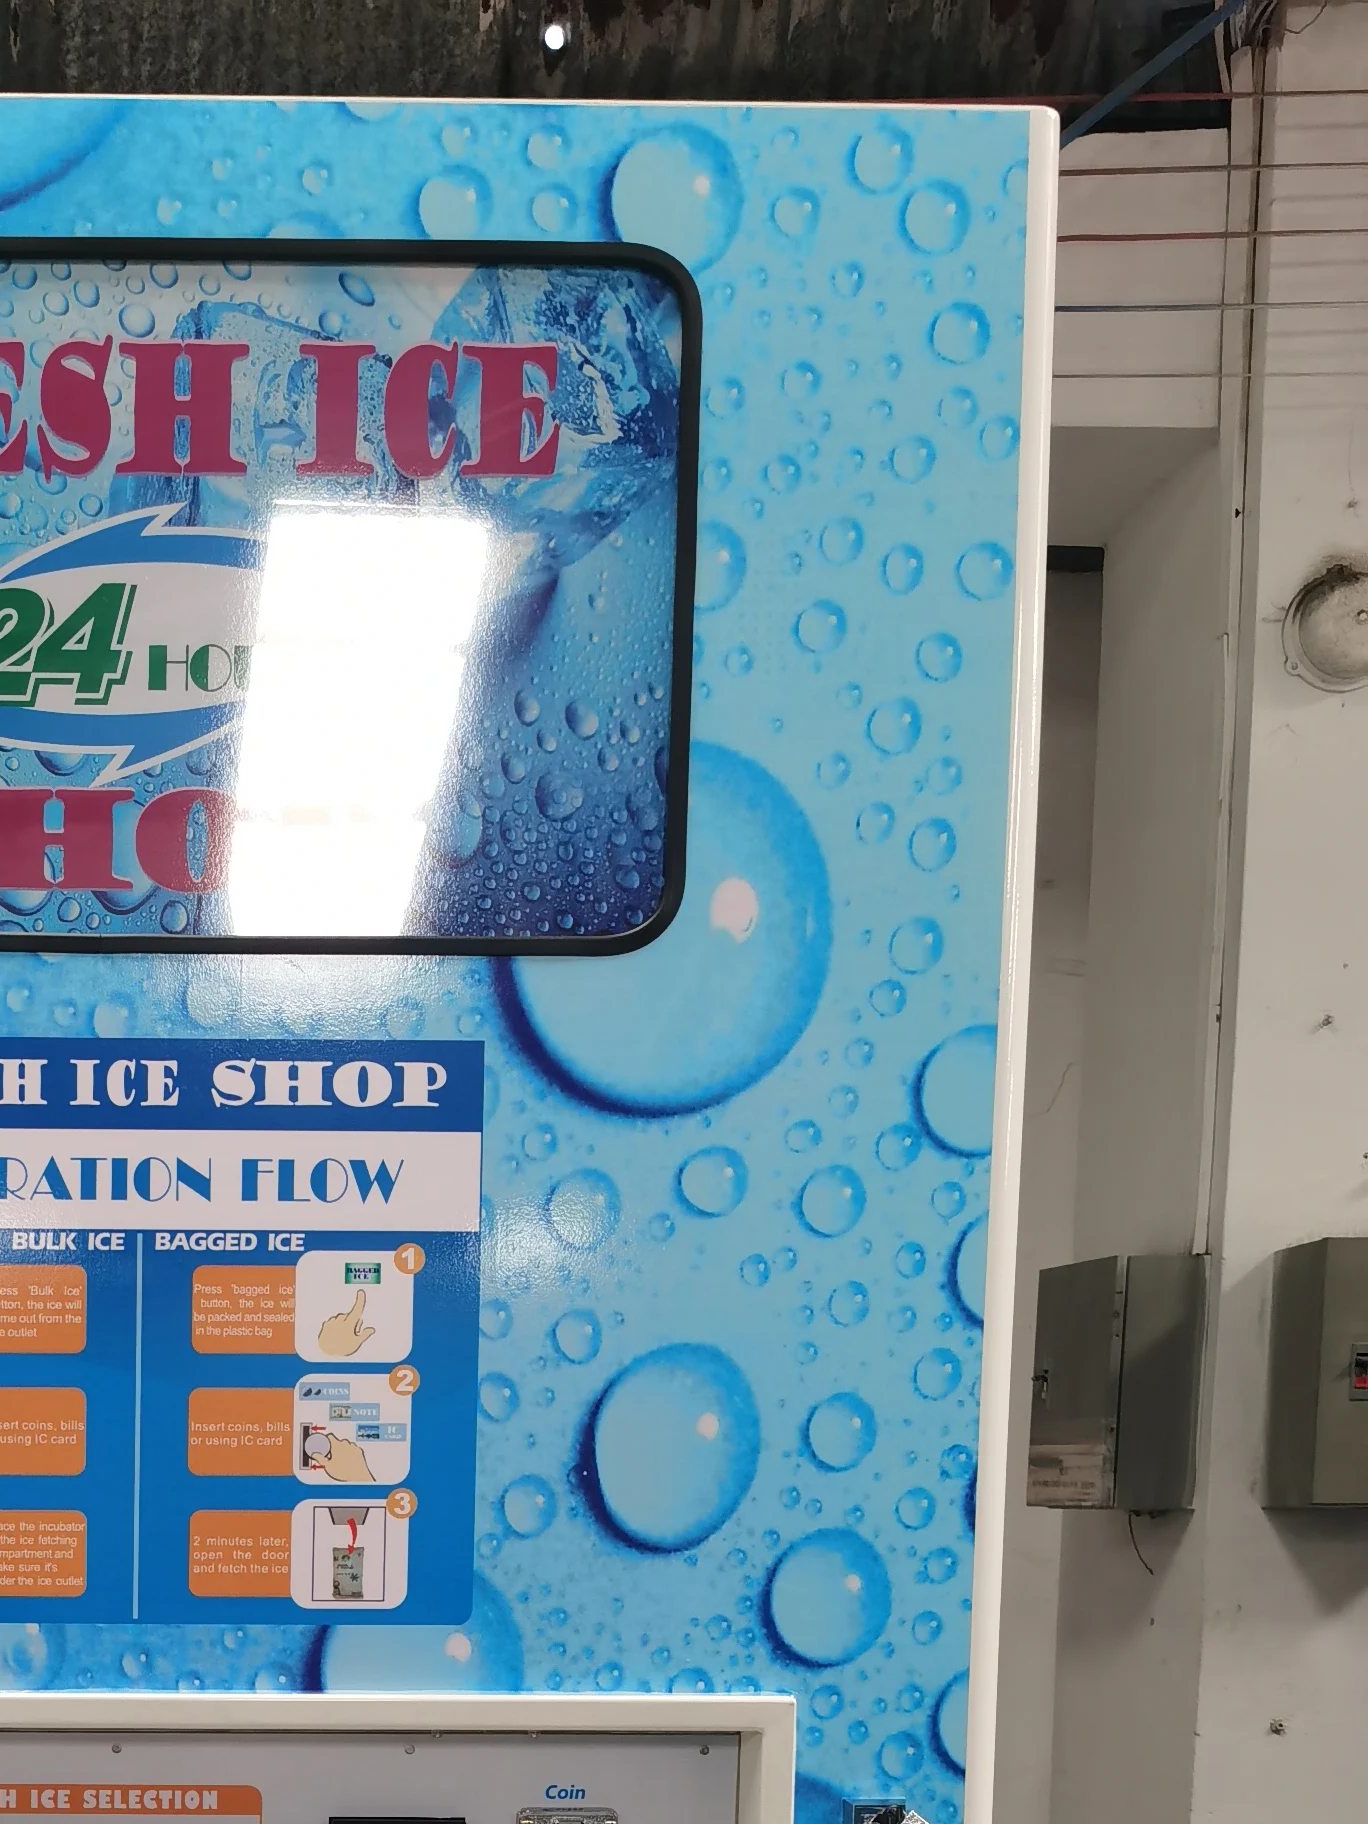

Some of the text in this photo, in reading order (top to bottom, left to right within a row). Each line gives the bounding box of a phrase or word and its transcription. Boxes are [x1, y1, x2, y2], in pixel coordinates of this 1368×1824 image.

[295, 340, 559, 478] ICE
[69, 1059, 179, 1107] ICE
[212, 1058, 447, 1110] SHOP
[241, 1158, 404, 1204] FLOW
[12, 1232, 125, 1250] BULK ICE
[155, 1232, 305, 1251] BAGGED ICE
[401, 1247, 415, 1270] 1
[194, 1284, 222, 1294] Press
[27, 1300, 43, 1309] the
[47, 1300, 62, 1309] ice
[65, 1300, 82, 1310] will
[200, 1298, 296, 1309] button, the ice will
[20, 1314, 36, 1323] out
[38, 1314, 62, 1323] from
[65, 1314, 82, 1323] the
[194, 1312, 294, 1325] be packed and sealed
[8, 1327, 37, 1337] outlet
[196, 1326, 272, 1338] in the plastic bag
[396, 1370, 414, 1391] 2
[61, 1421, 84, 1431] bills
[191, 1422, 224, 1432] Insert
[267, 1422, 290, 1432] bills
[0, 1435, 32, 1447] using
[35, 1434, 47, 1444] IC
[51, 1434, 76, 1444] card
[191, 1436, 282, 1448] or using IC card
[393, 1492, 411, 1515] 3
[20, 1521, 35, 1531] the
[39, 1521, 85, 1531] incubator
[0, 1535, 15, 1544] the
[20, 1535, 34, 1545] ice
[38, 1535, 77, 1547] fetching
[194, 1536, 289, 1547] 2 minutes later,
[55, 1549, 73, 1558] and
[194, 1550, 289, 1561] open the door
[19, 1564, 40, 1572] sure
[45, 1563, 58, 1572] it's
[194, 1564, 288, 1573] and fetch the ice
[18, 1576, 33, 1586] the
[37, 1576, 52, 1586] ice
[56, 1576, 83, 1586] outlet
[545, 1784, 586, 1800] Coin
[30, 1790, 70, 1809] ICE
[82, 1790, 218, 1810] SELECTION
